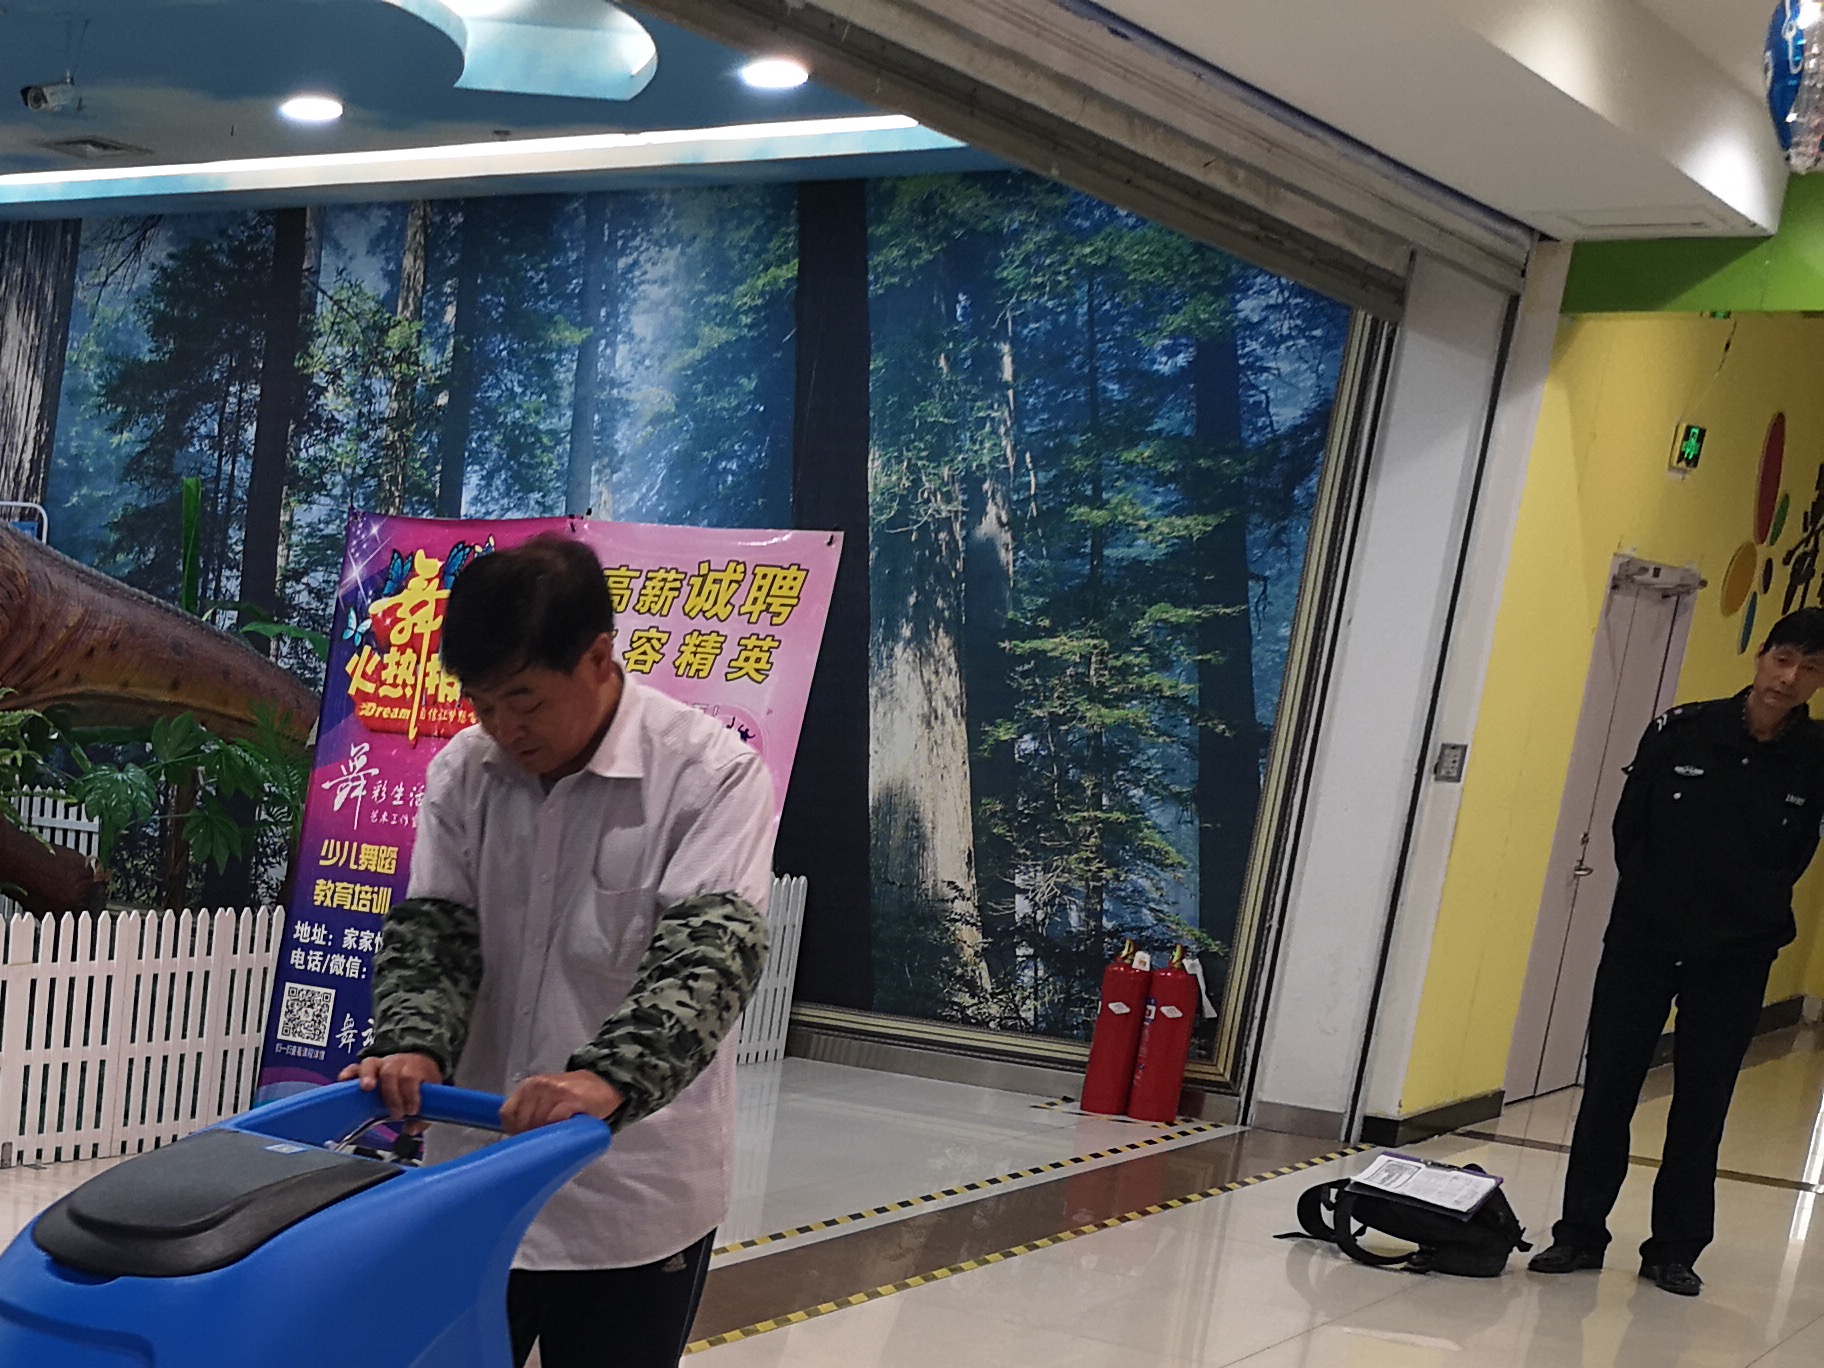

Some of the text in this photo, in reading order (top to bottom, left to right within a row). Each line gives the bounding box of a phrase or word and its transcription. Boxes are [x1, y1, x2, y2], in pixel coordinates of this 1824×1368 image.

[601, 560, 809, 625] 高薪诚聘
[611, 626, 782, 684] 容精英
[319, 839, 399, 875] 少儿舞蹈
[313, 878, 392, 914] 教育培训
